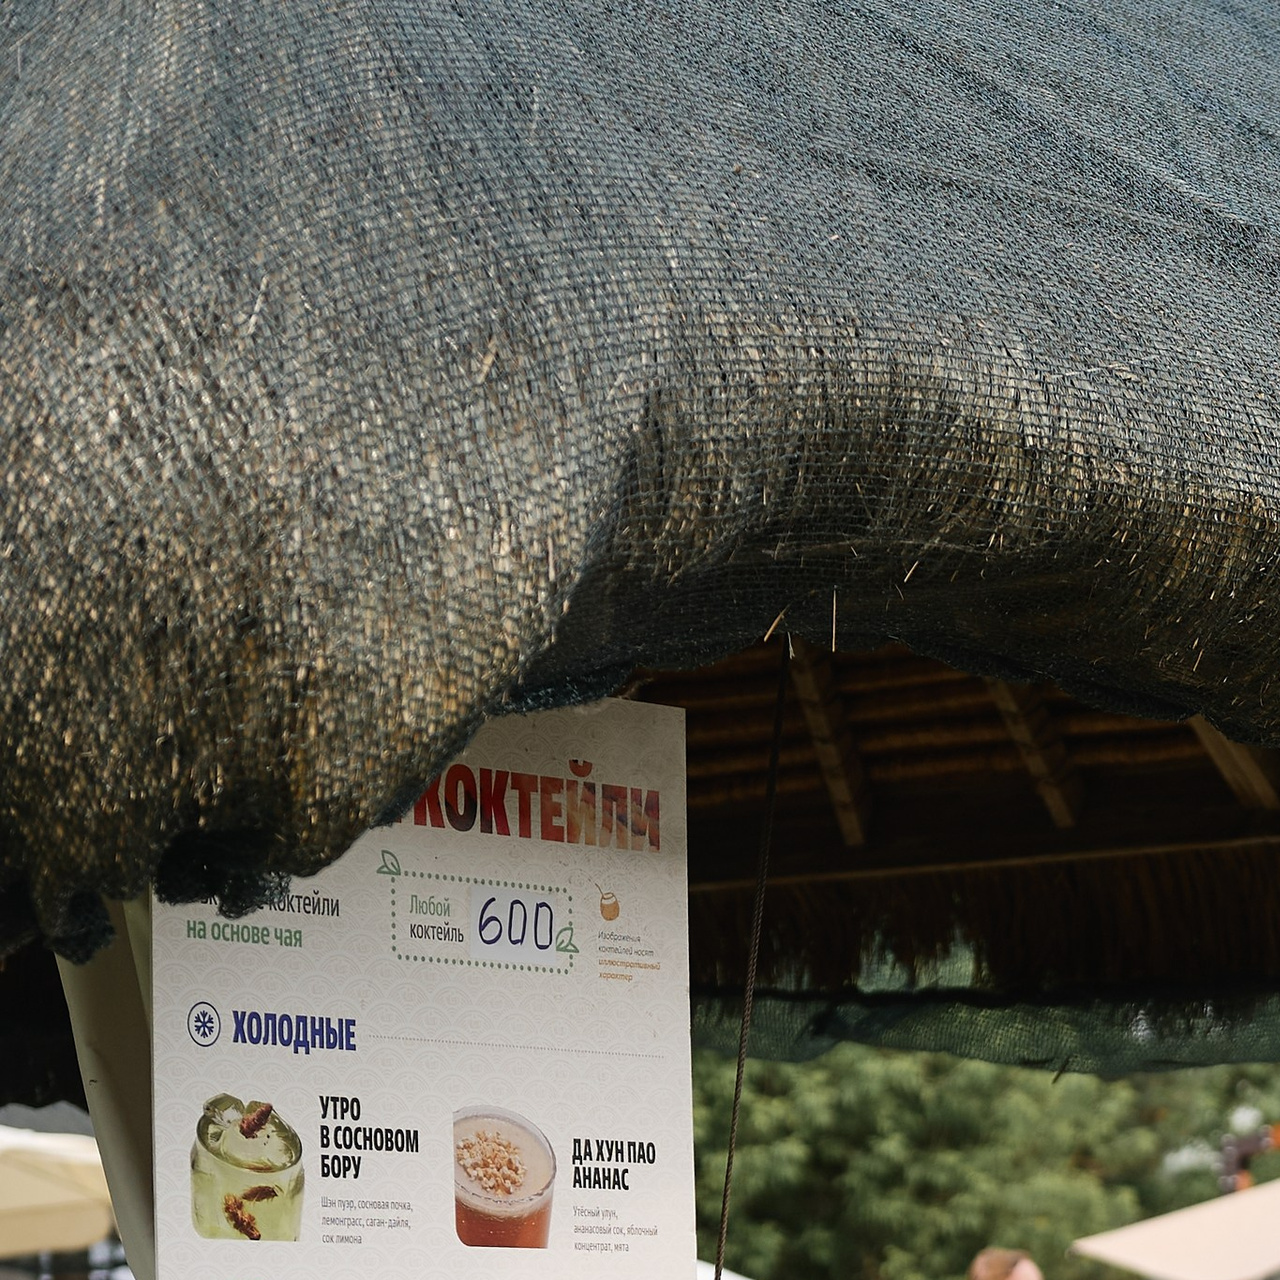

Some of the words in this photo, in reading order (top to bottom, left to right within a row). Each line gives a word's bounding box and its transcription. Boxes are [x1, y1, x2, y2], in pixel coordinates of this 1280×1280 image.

[413, 759, 660, 851] КОКТЕЙЛИ
[410, 894, 451, 917] Любой
[187, 919, 206, 940] на
[211, 922, 270, 945] основе
[273, 928, 303, 948] чая
[410, 921, 464, 943] коктейль
[478, 897, 553, 950] 600
[599, 959, 660, 970] иллюстративный
[232, 1009, 357, 1054] ХОЛОДНЫЕ
[319, 1095, 361, 1121] УТРО
[320, 1125, 330, 1149] В
[333, 1125, 419, 1153] СОСНОВОМ
[572, 1138, 593, 1165] ДА
[595, 1139, 624, 1163] ХУН
[627, 1141, 656, 1164] ПАО
[321, 1154, 361, 1179] БОРУ
[572, 1166, 630, 1191] АНАНАС
[321, 1196, 337, 1208] Шэн
[337, 1198, 357, 1211] пуэр,
[357, 1199, 389, 1210] сосновая
[390, 1200, 413, 1212] почка,
[573, 1206, 600, 1217] Утёсный
[601, 1208, 618, 1220] улун,
[321, 1215, 365, 1229] лемонграсс,
[366, 1216, 411, 1230] саган-дайля,
[574, 1224, 612, 1235] ананасовый
[612, 1226, 626, 1236] сок,
[626, 1224, 658, 1236] яблочный
[322, 1234, 335, 1244] сок
[336, 1235, 362, 1245] лимона
[574, 1242, 613, 1253] концентрат,
[613, 1243, 630, 1252] мята
